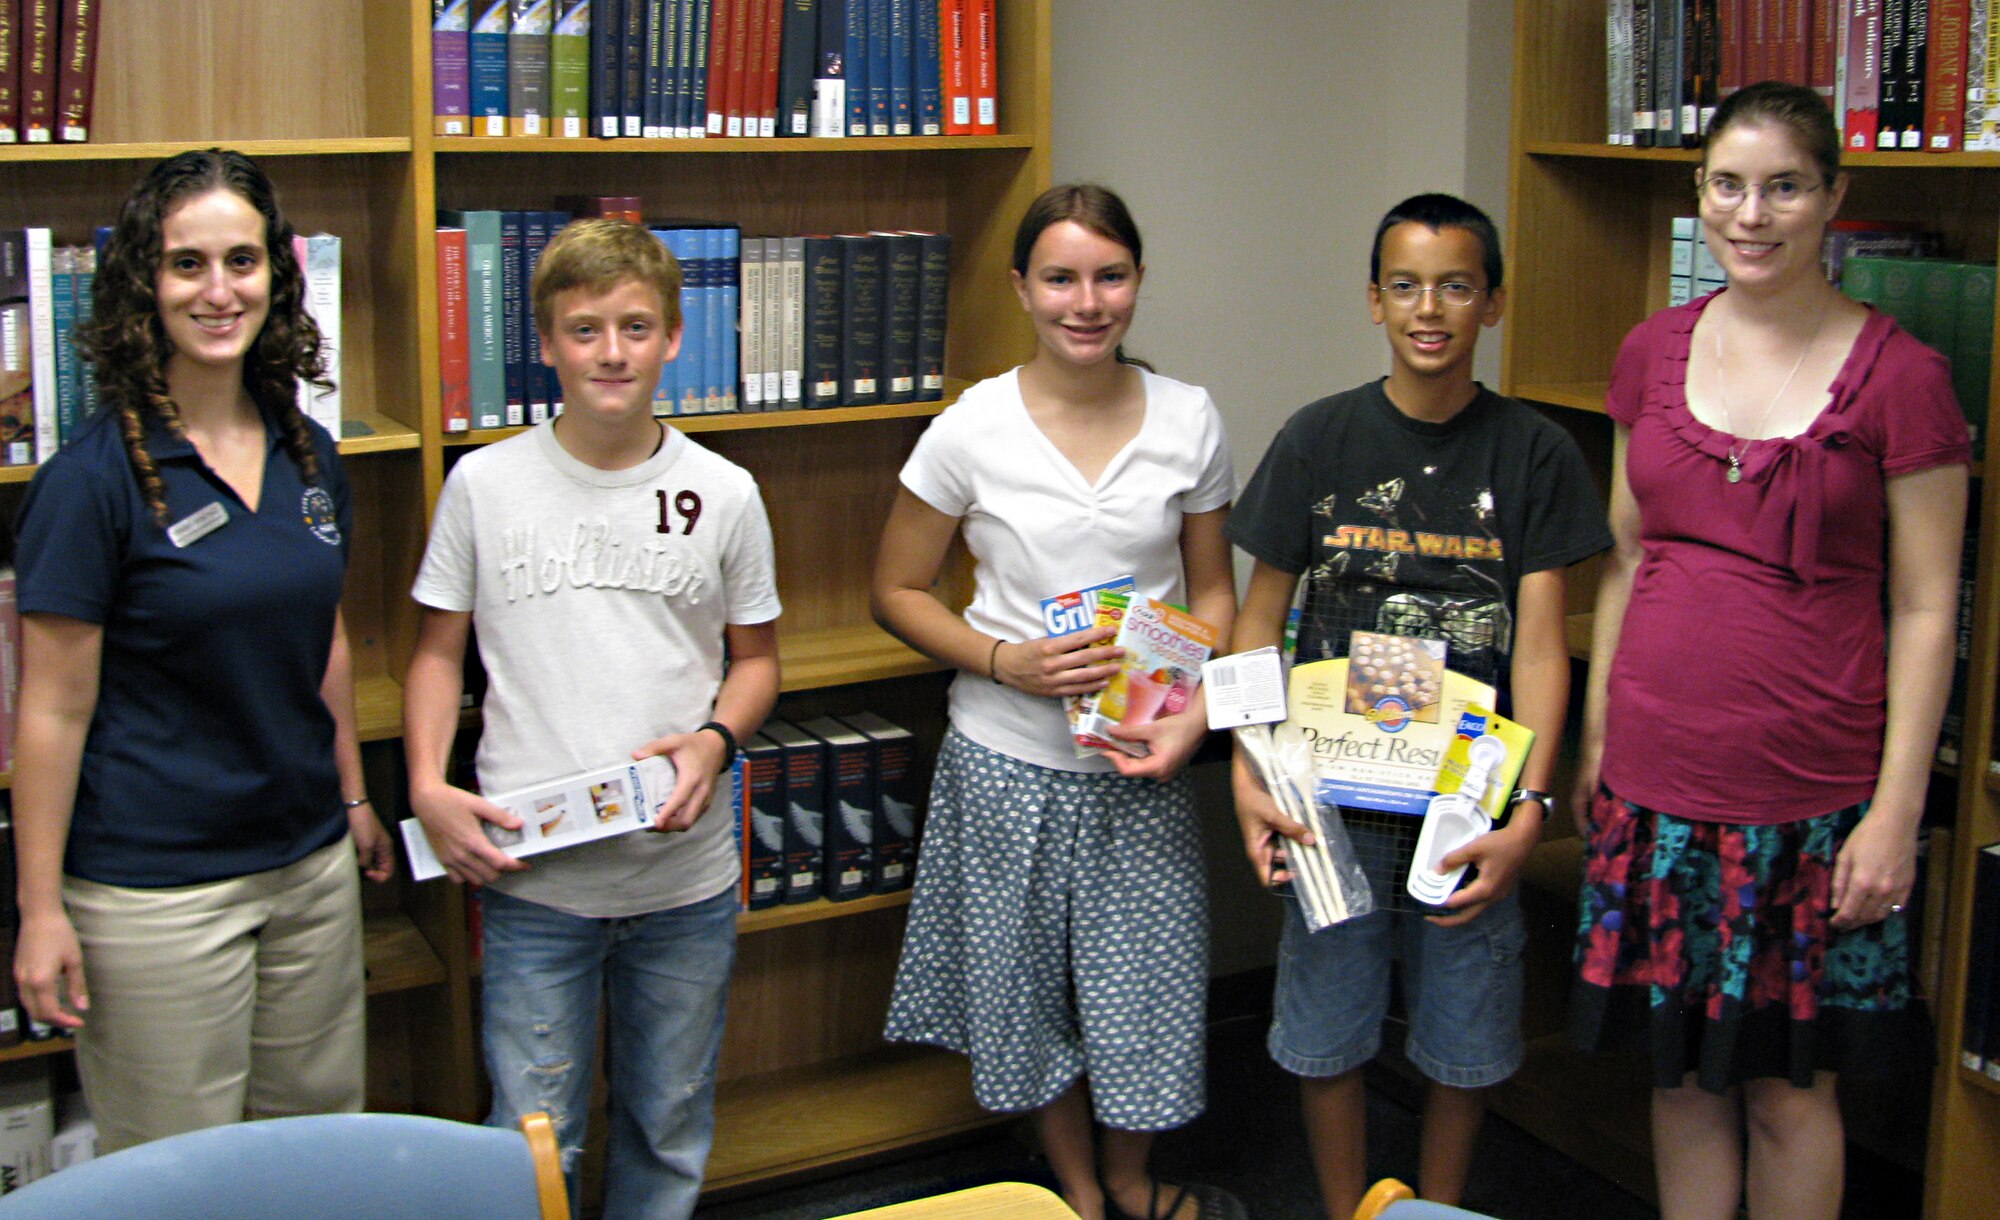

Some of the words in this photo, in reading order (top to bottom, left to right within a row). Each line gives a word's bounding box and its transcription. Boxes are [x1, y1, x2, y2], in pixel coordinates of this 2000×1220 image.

[655, 488, 702, 535] 19
[500, 515, 706, 605] Hollister
[1323, 524, 1415, 555] STAR
[1413, 531, 1504, 561] WARS
[1125, 616, 1206, 661] smoothies
[1302, 727, 1384, 763] Perfect
